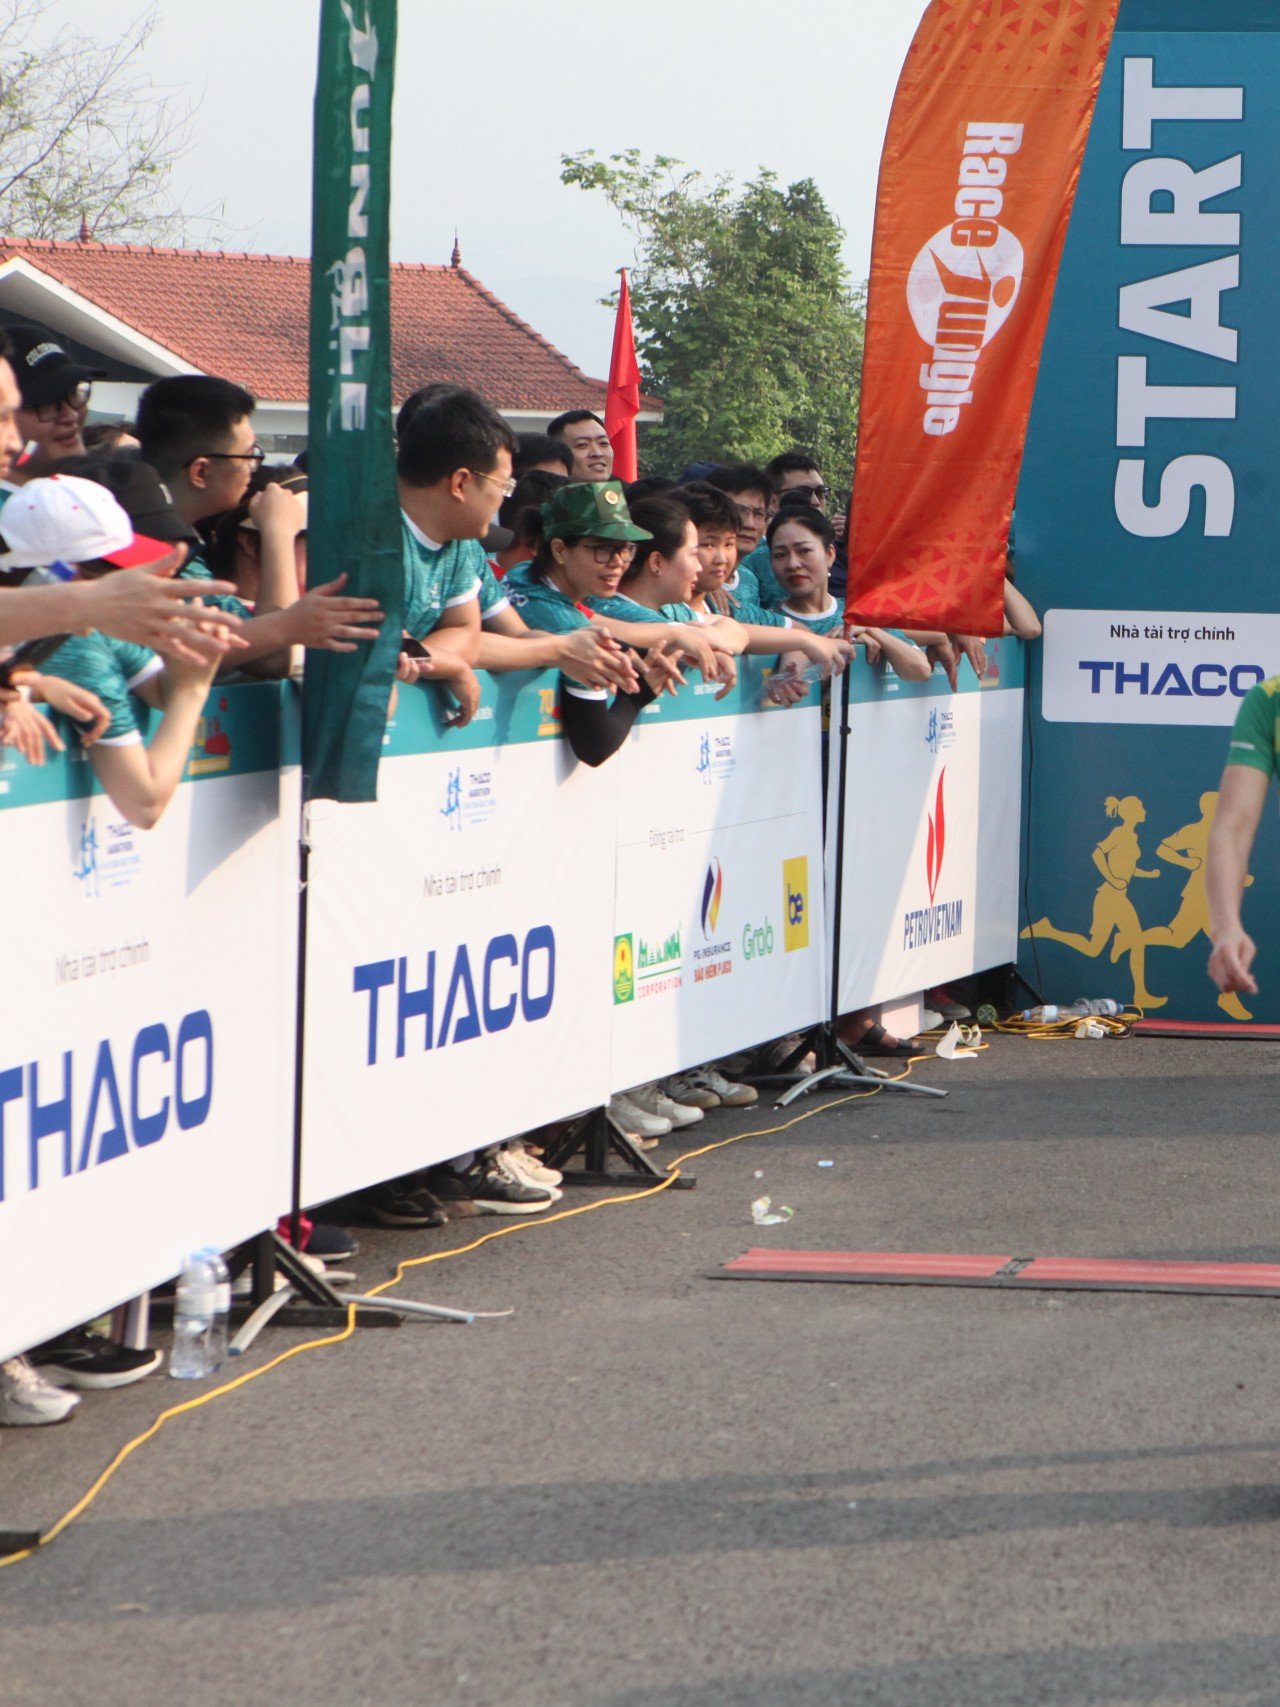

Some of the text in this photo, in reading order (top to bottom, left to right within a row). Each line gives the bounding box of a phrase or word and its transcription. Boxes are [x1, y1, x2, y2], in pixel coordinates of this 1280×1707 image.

[951, 122, 1024, 248] Race
[919, 247, 1006, 436] Jungle
[1114, 56, 1244, 538] START
[1079, 661, 1265, 697] THACO
[1110, 625, 1235, 643] Nhà tài trợ chính
[742, 916, 775, 961] Grab
[903, 899, 964, 951] PETROVIETNAM
[353, 924, 556, 1067] THACO
[0, 1009, 213, 1200] THACO
